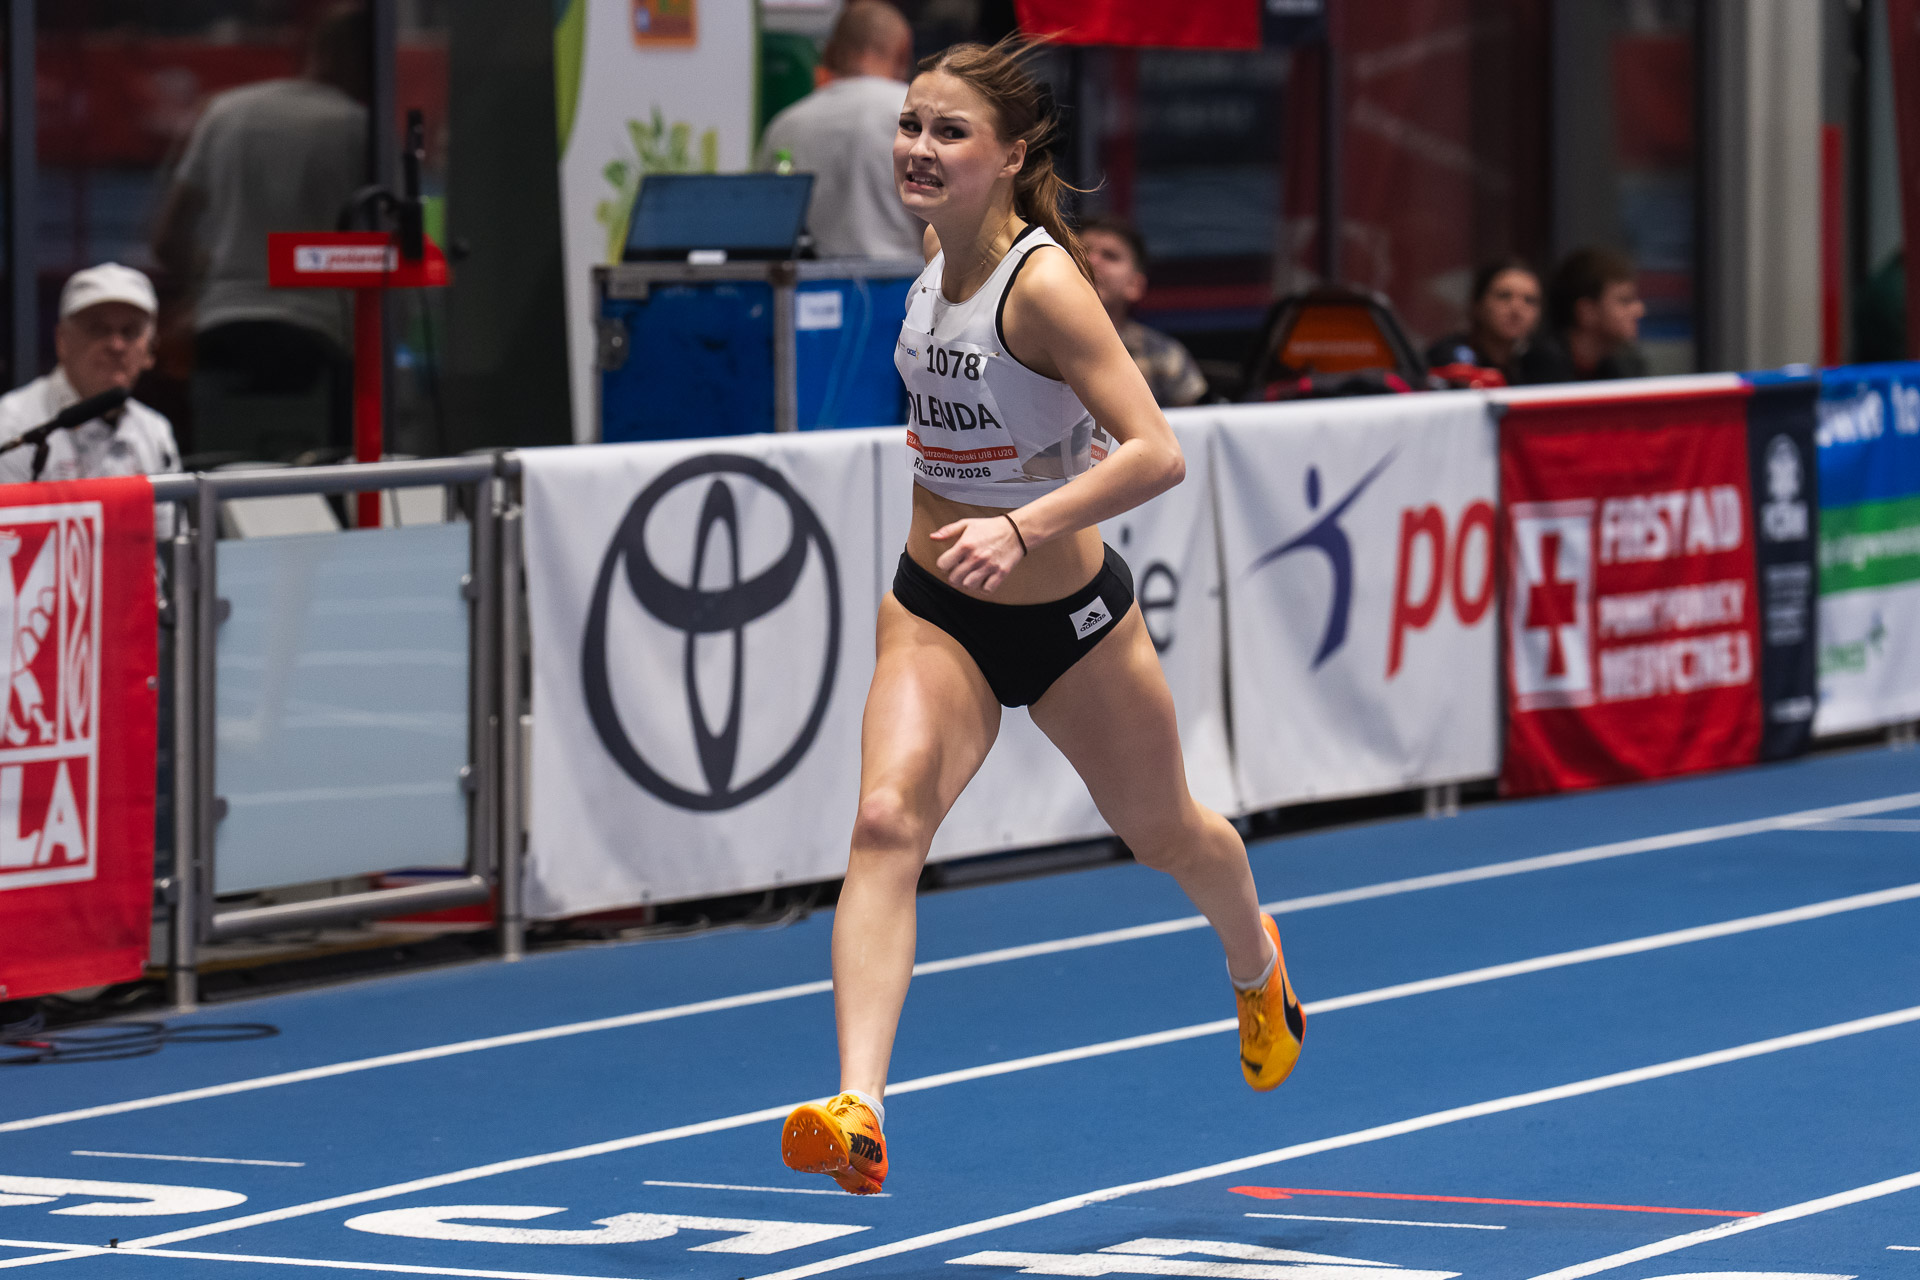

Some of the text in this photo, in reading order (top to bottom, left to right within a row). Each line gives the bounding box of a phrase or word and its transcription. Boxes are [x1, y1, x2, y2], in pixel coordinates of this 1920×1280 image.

[926, 344, 981, 381] 1078
[914, 456, 992, 479] RZSZÓW 2026
[954, 452, 977, 462] Polski
[977, 450, 993, 460] U18
[997, 448, 1014, 458] U20
[1384, 500, 1499, 683] po
[1080, 613, 1106, 632] adidas
[847, 1131, 883, 1164] NITRO
